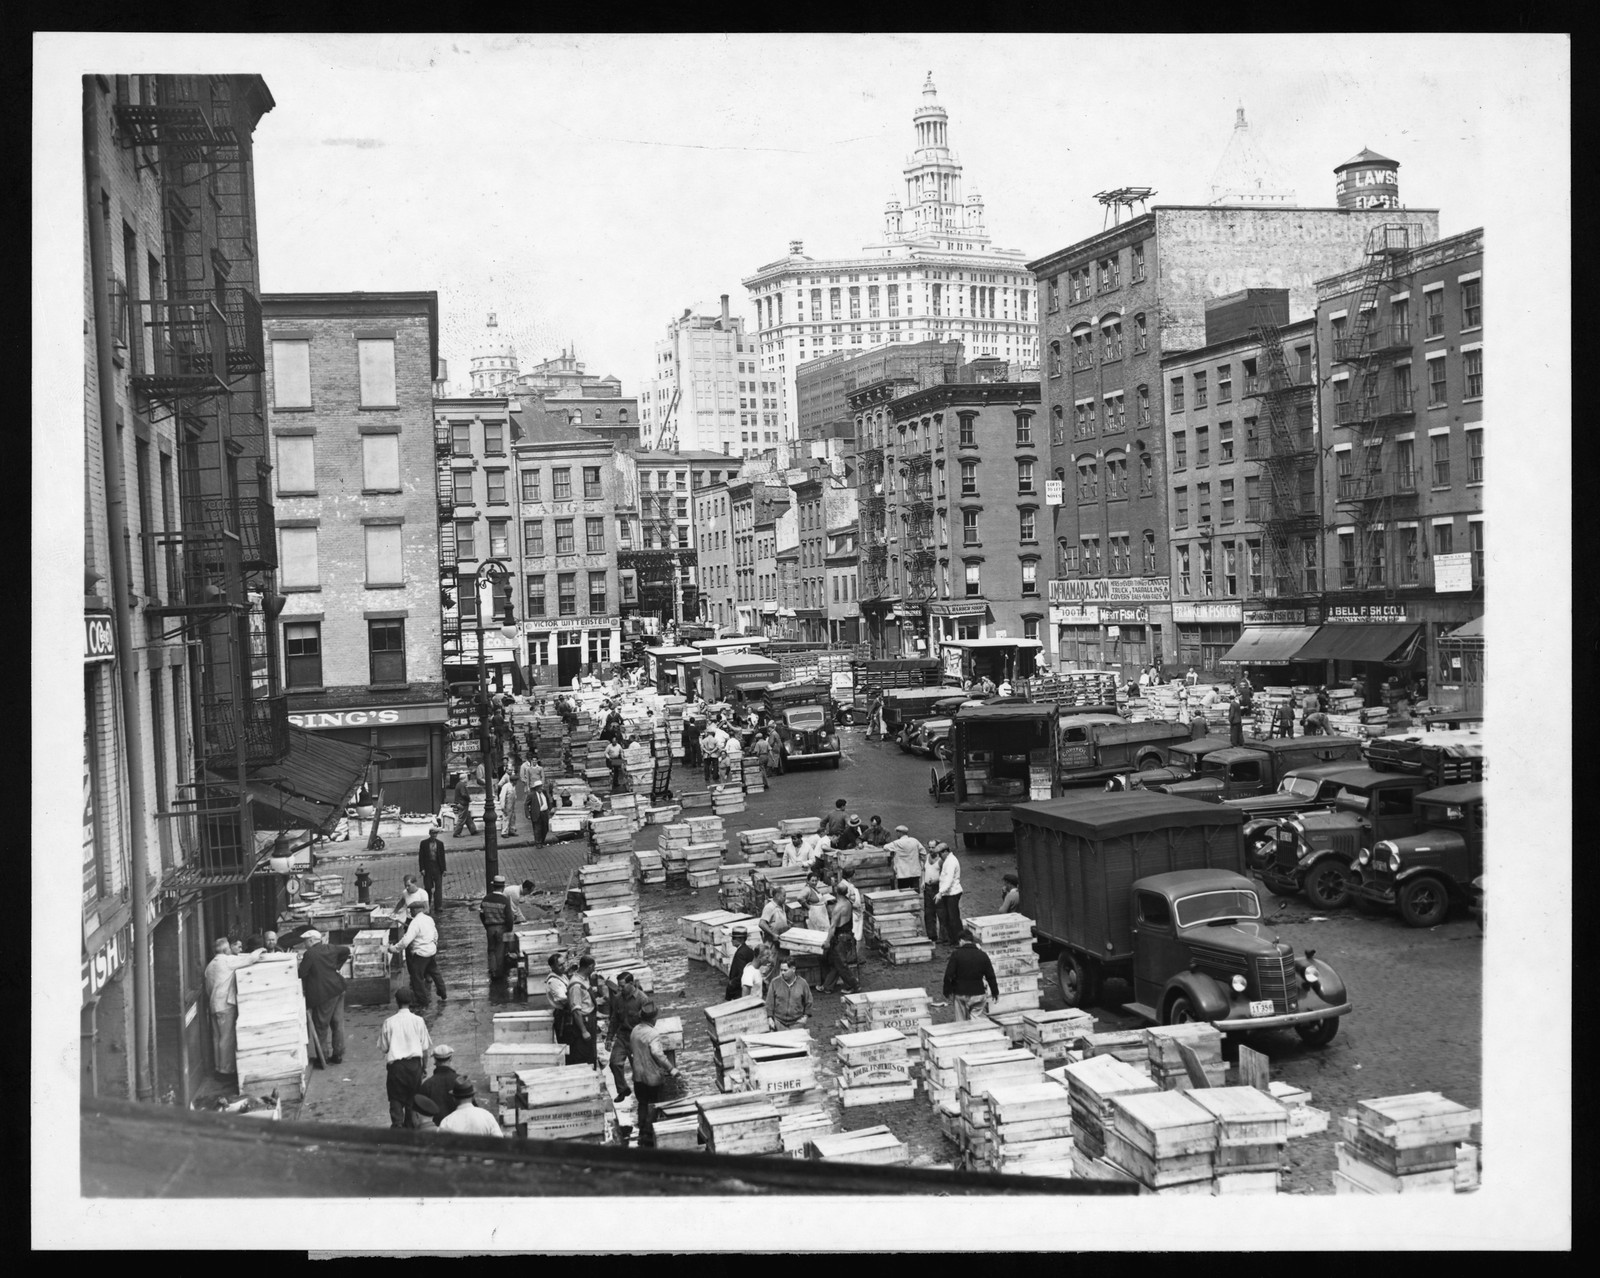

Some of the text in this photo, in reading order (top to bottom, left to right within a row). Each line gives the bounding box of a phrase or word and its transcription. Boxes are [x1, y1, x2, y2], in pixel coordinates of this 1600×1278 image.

[1094, 580, 1109, 599] SON
[1120, 609, 1135, 620] FISH
[1174, 605, 1209, 618] FRANKLIN
[1209, 605, 1225, 617] FISH
[1335, 606, 1358, 616] BELL
[1360, 606, 1381, 616] FISH
[533, 620, 558, 628] VICTOR
[884, 1018, 919, 1028] KOLBE
[767, 1079, 801, 1091] FISHER
